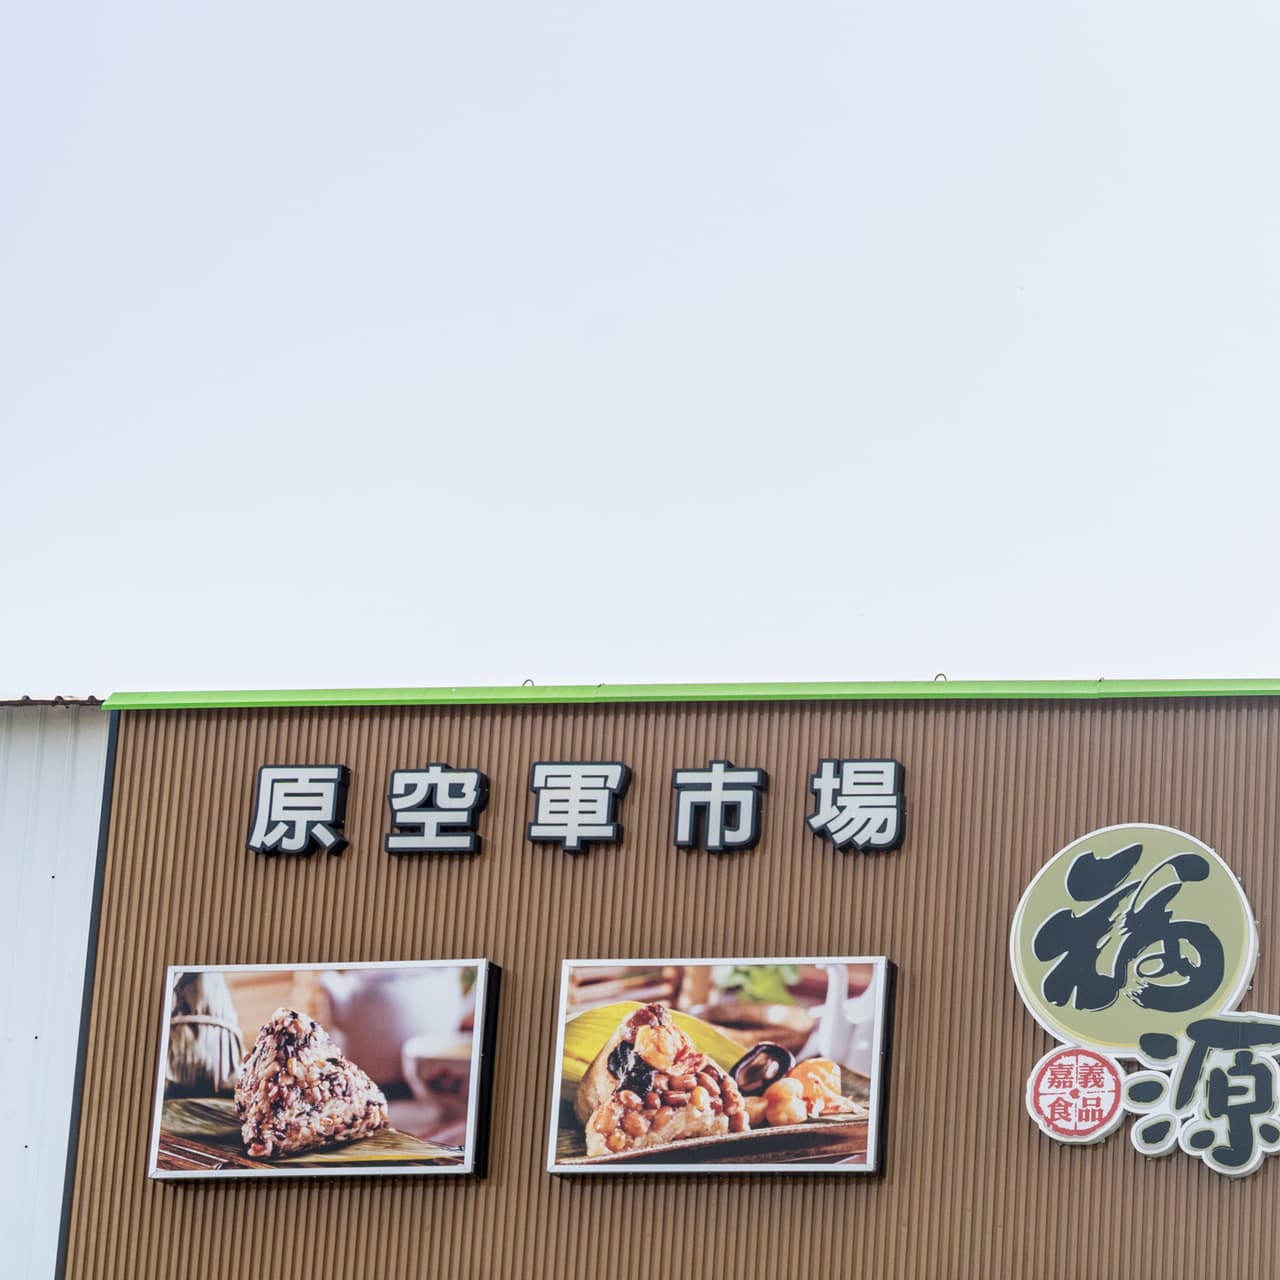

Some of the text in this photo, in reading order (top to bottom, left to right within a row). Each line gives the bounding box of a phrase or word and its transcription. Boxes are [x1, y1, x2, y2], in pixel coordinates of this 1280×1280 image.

[247, 758, 906, 855] 原空軍市場
